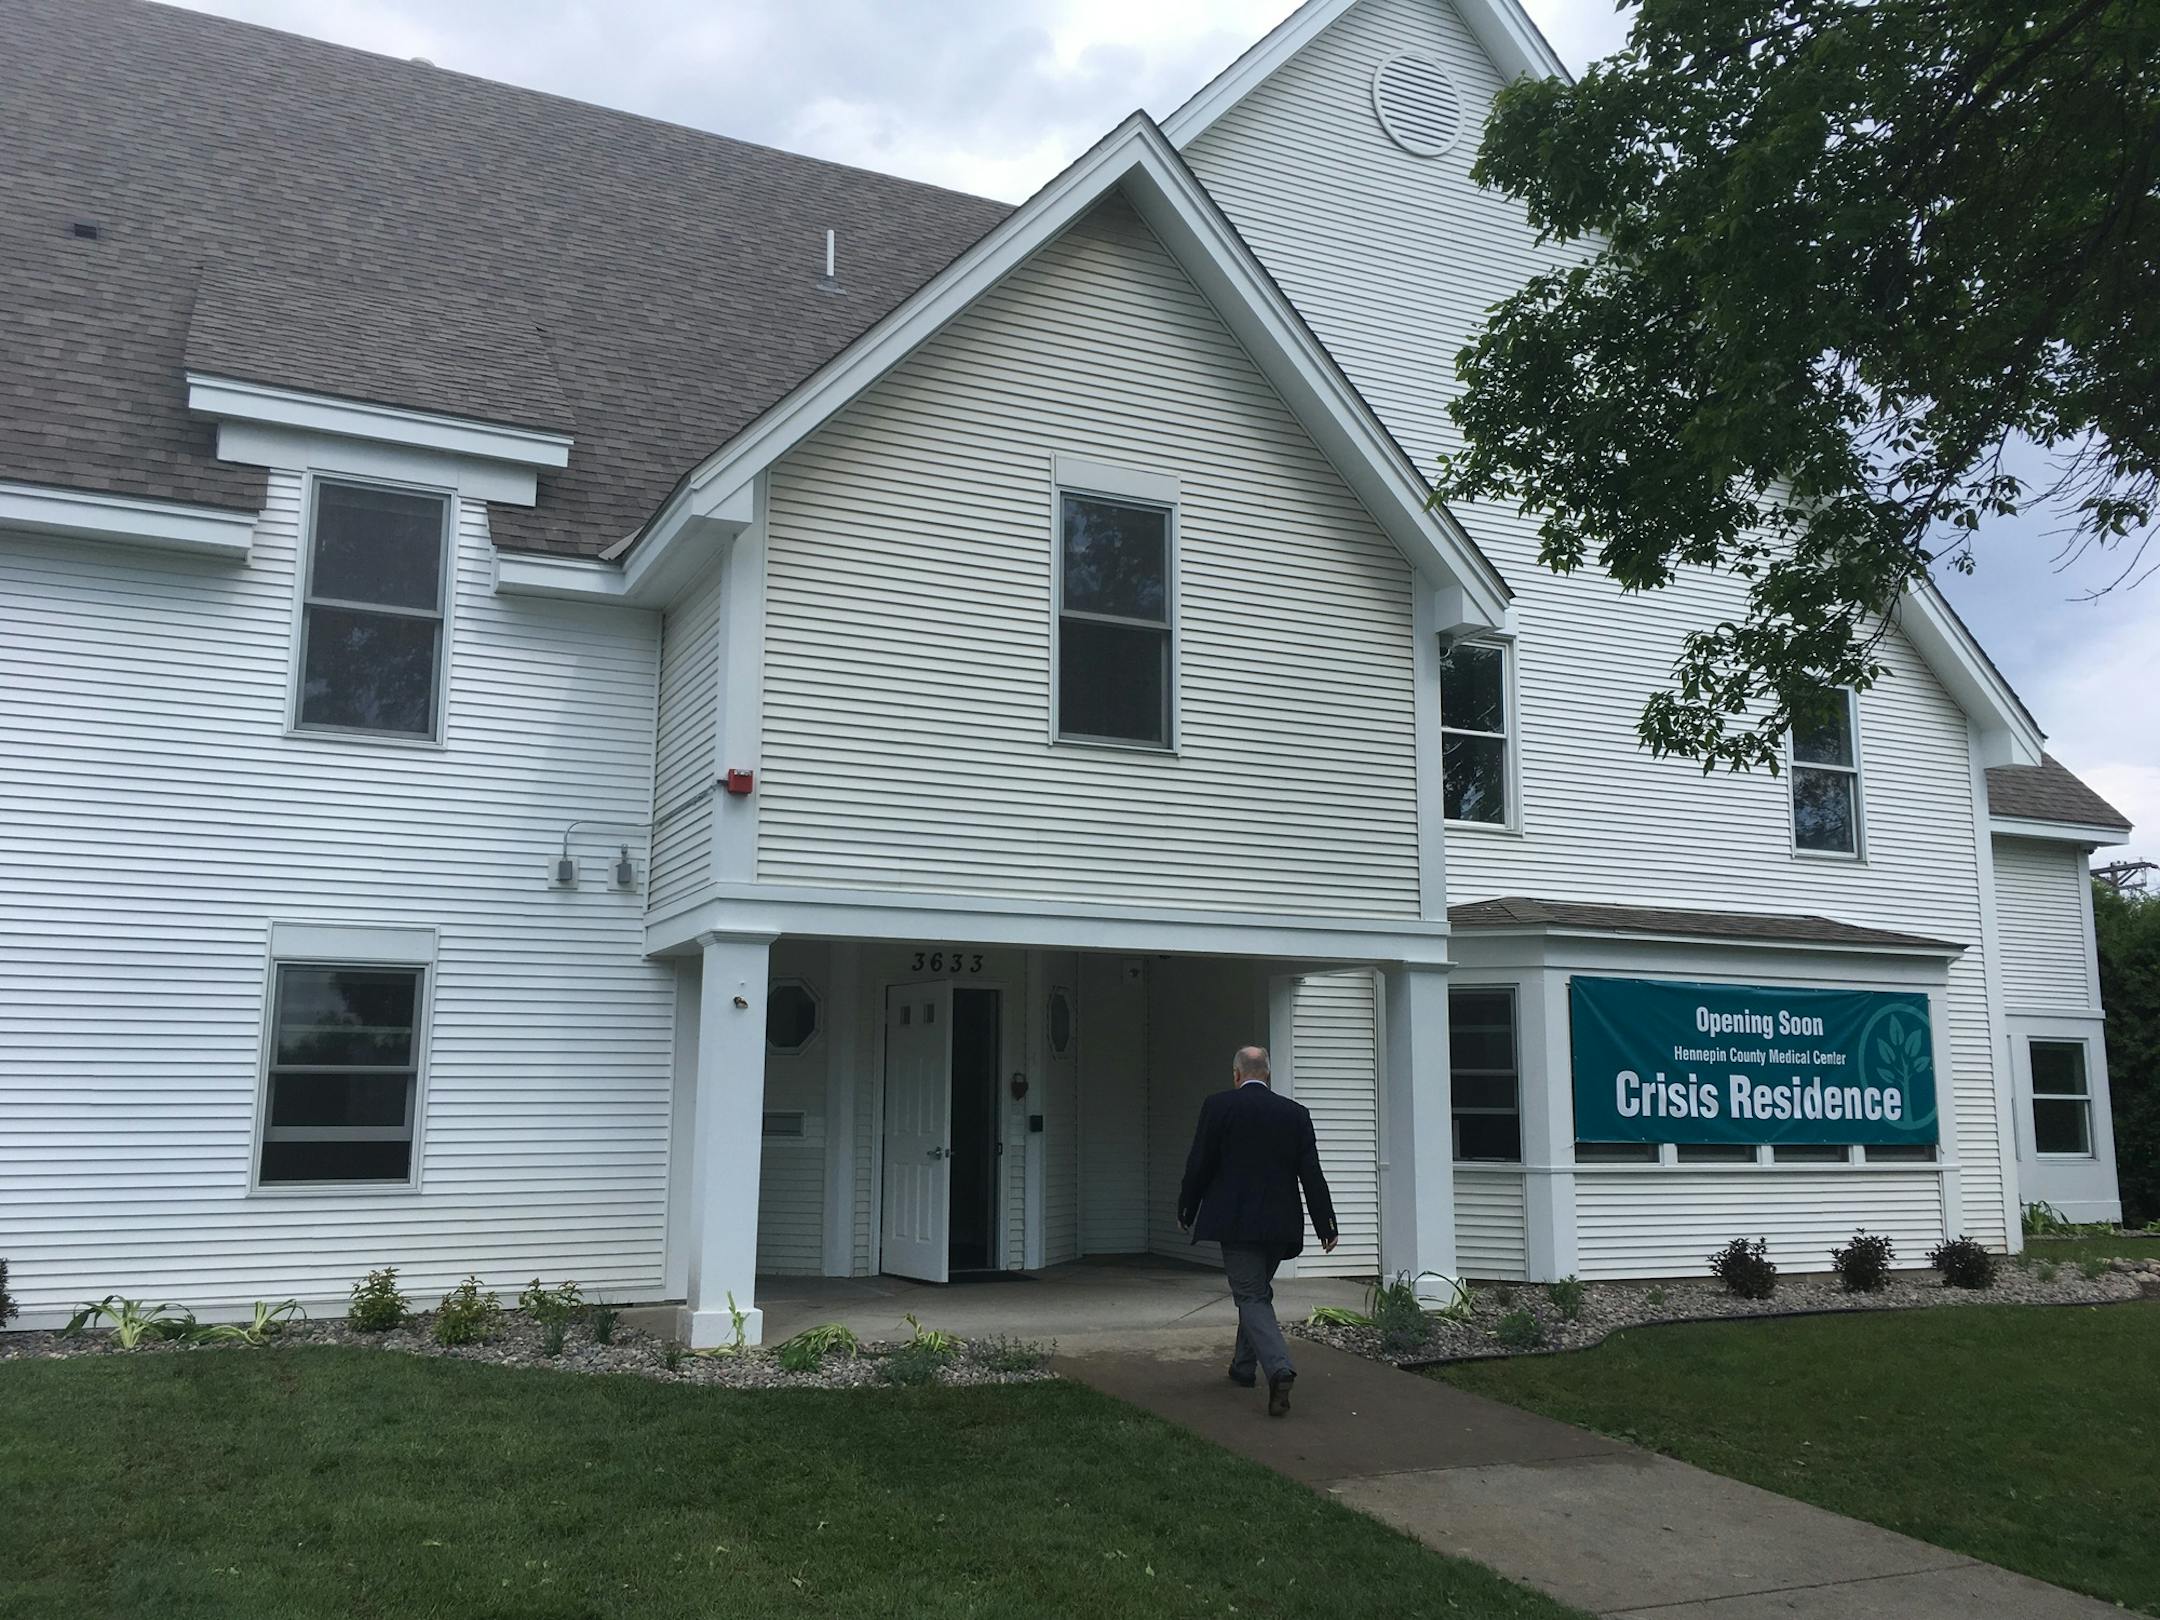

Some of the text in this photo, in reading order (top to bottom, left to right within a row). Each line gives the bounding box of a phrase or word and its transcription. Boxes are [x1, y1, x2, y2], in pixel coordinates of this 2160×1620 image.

[911, 952, 984, 973] 3633
[1695, 1006, 1824, 1039] Opening Soon
[1674, 1045, 1846, 1066] Hennepin County Medical Center
[1615, 1069, 1902, 1121] Crisis Residence
